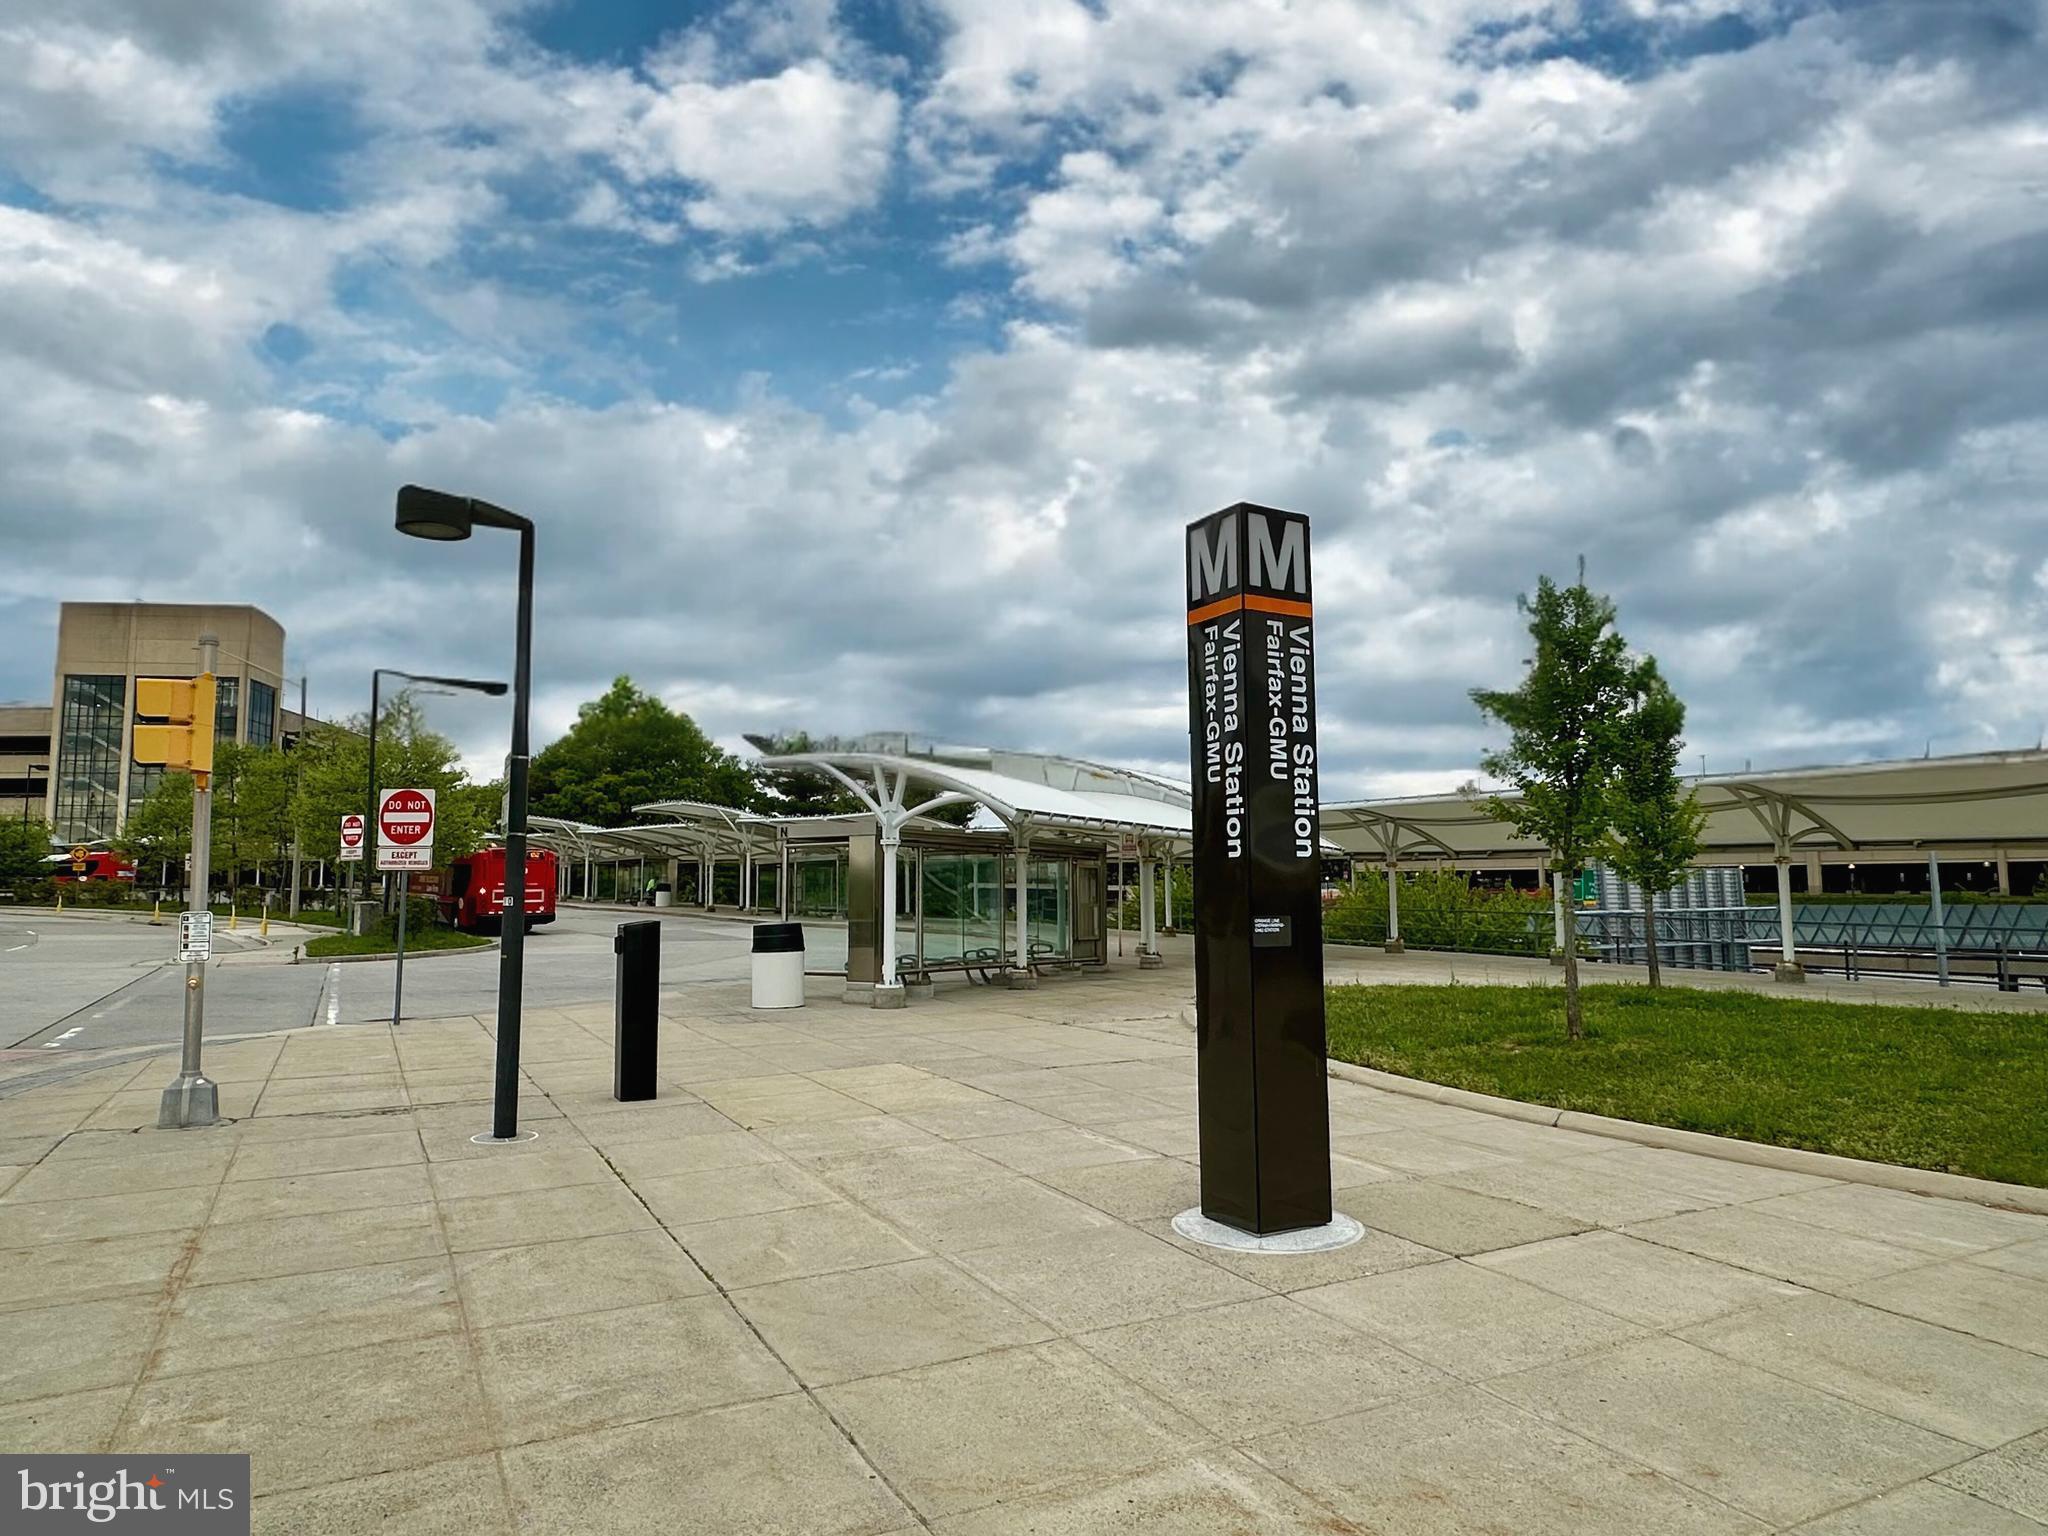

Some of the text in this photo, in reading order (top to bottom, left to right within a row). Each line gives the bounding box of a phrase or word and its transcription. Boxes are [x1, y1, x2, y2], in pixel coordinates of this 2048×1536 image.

[1190, 512, 1238, 602] M
[1247, 511, 1306, 594] M
[1204, 624, 1221, 783] Fairfax-GMU
[1222, 618, 1245, 858] Vienna Station
[1266, 619, 1288, 780] Fairfax-GMU
[1289, 625, 1316, 858] Vienna Station
[388, 800, 427, 810] DO NOT
[390, 825, 421, 835] ENTER
[780, 826, 788, 838] N
[391, 851, 418, 860] EXCEPT
